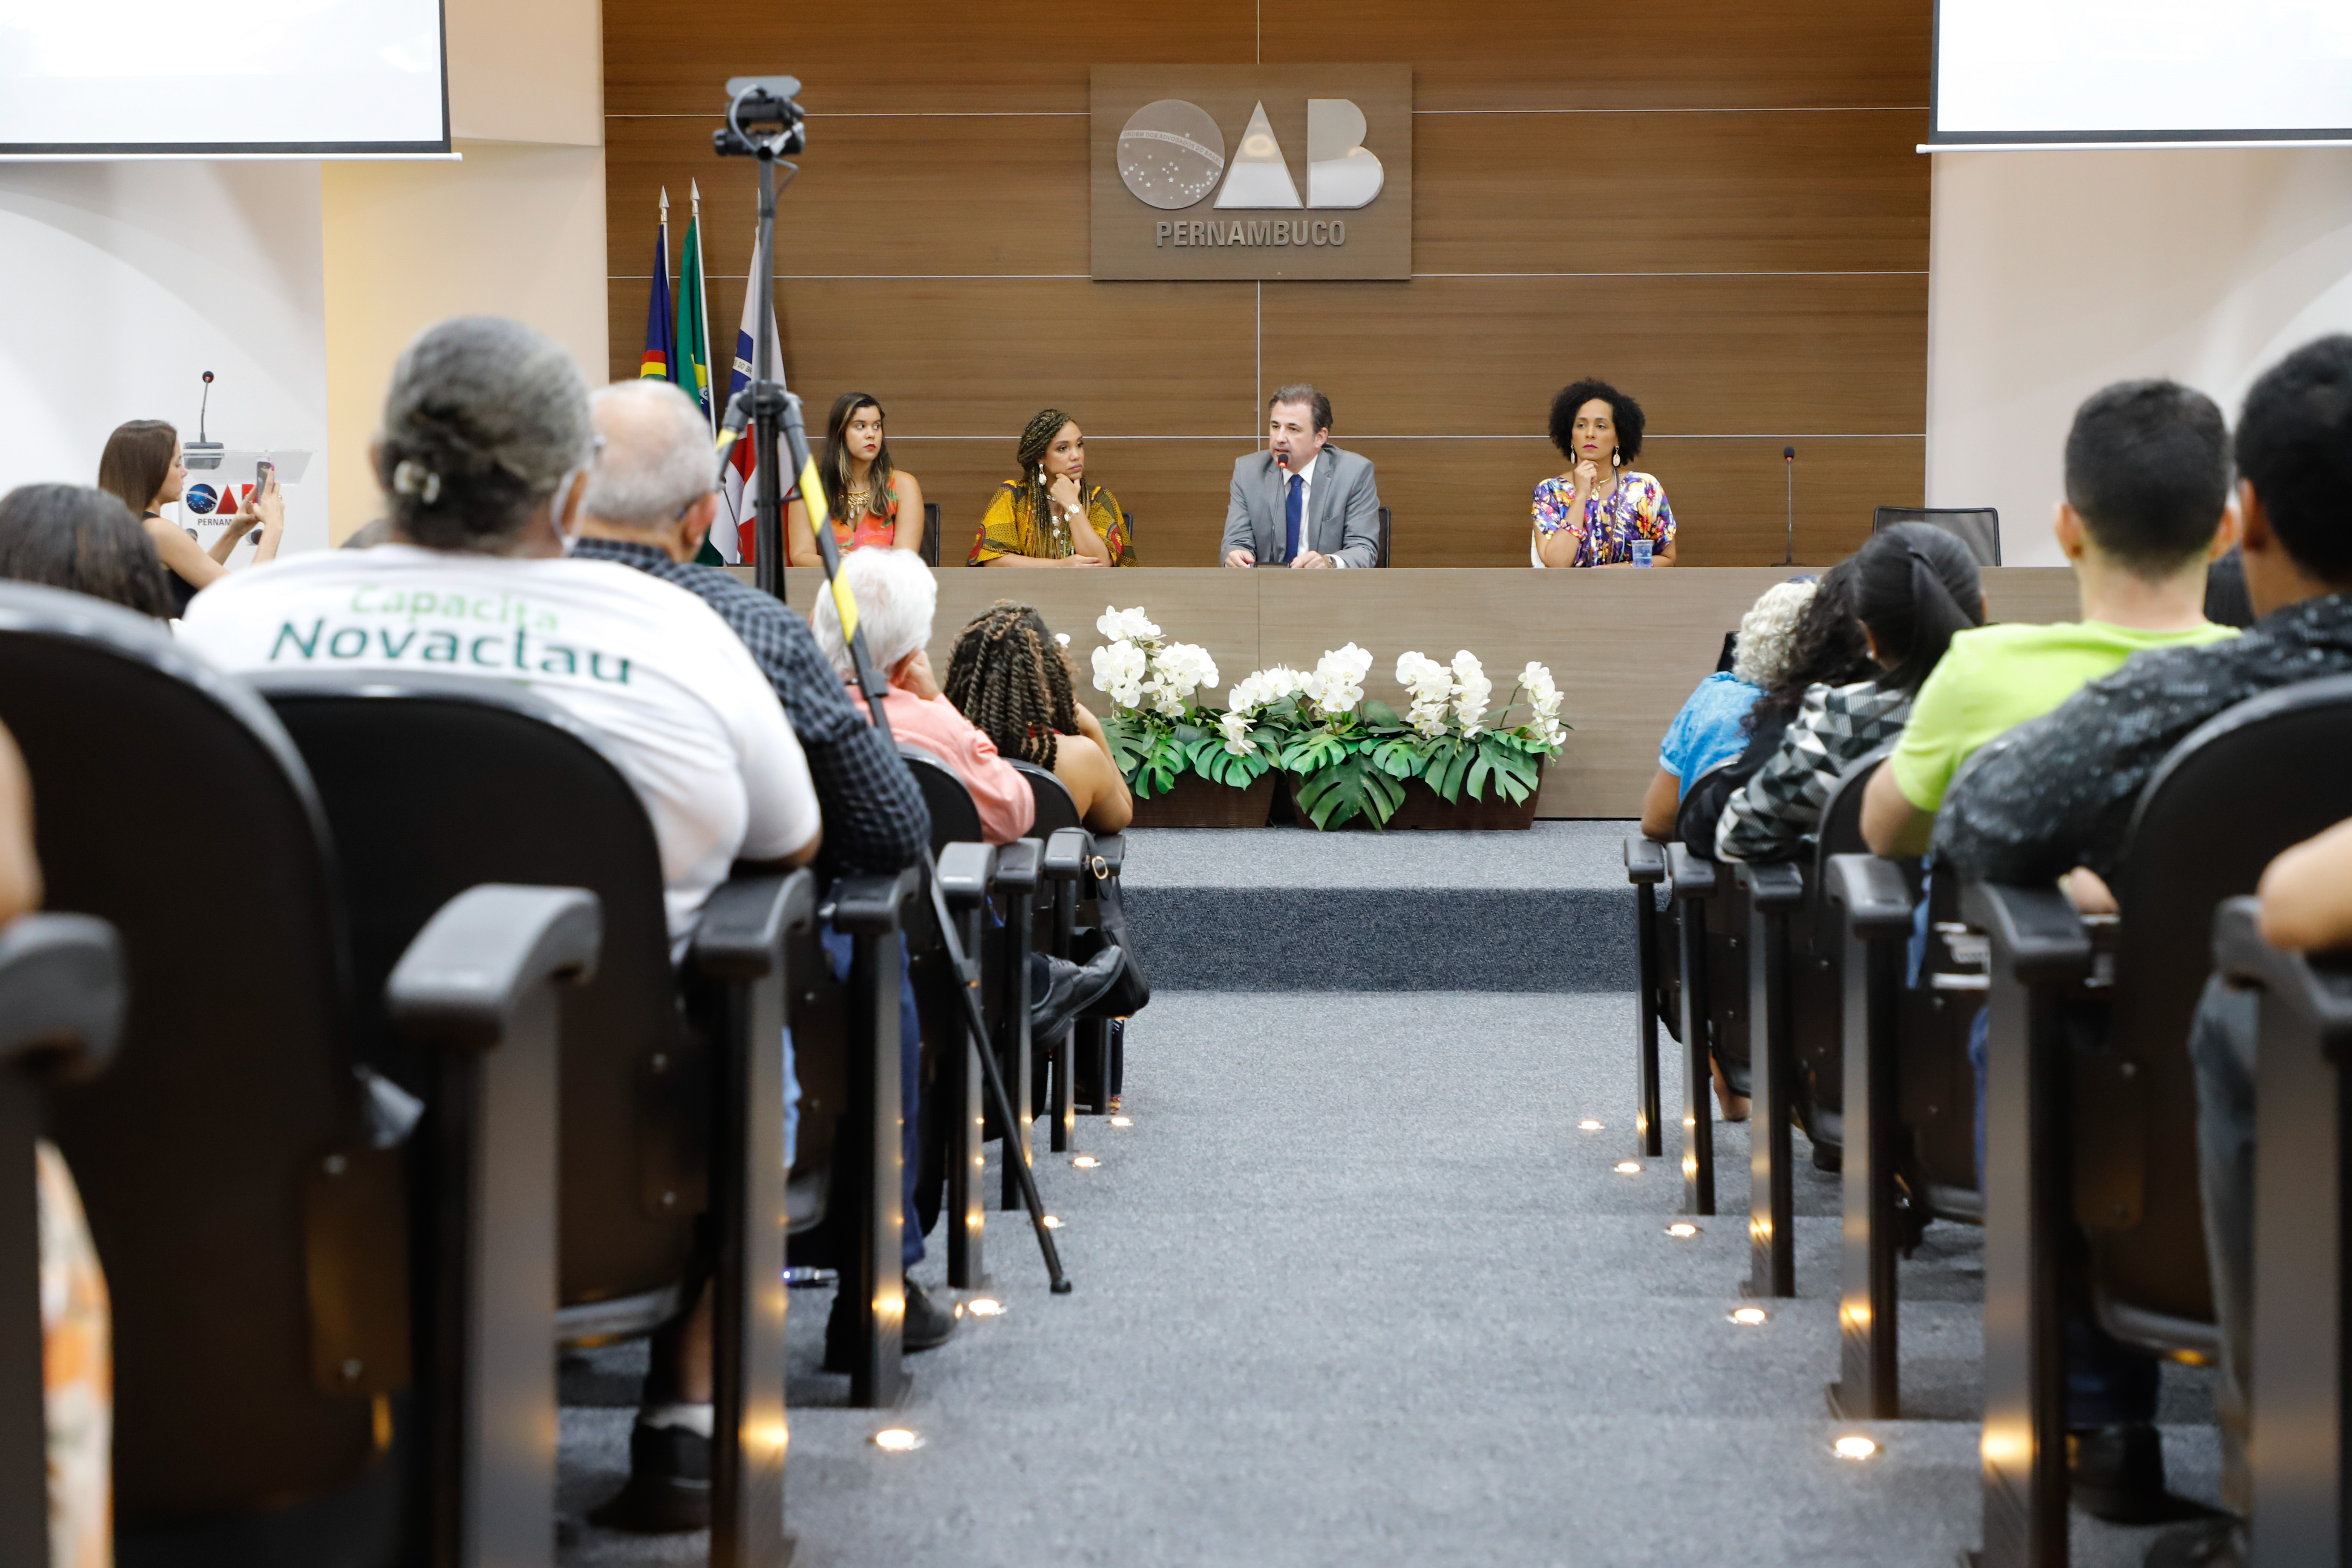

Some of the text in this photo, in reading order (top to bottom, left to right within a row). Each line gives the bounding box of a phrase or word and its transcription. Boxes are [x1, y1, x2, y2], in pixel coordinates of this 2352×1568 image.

[1117, 99, 1384, 209] OAB
[1159, 133, 1194, 149] ADVOGADOS
[1204, 150, 1222, 165] BRASIL
[1156, 220, 1345, 247] PERNAMBUCO
[351, 584, 558, 630] Capacita
